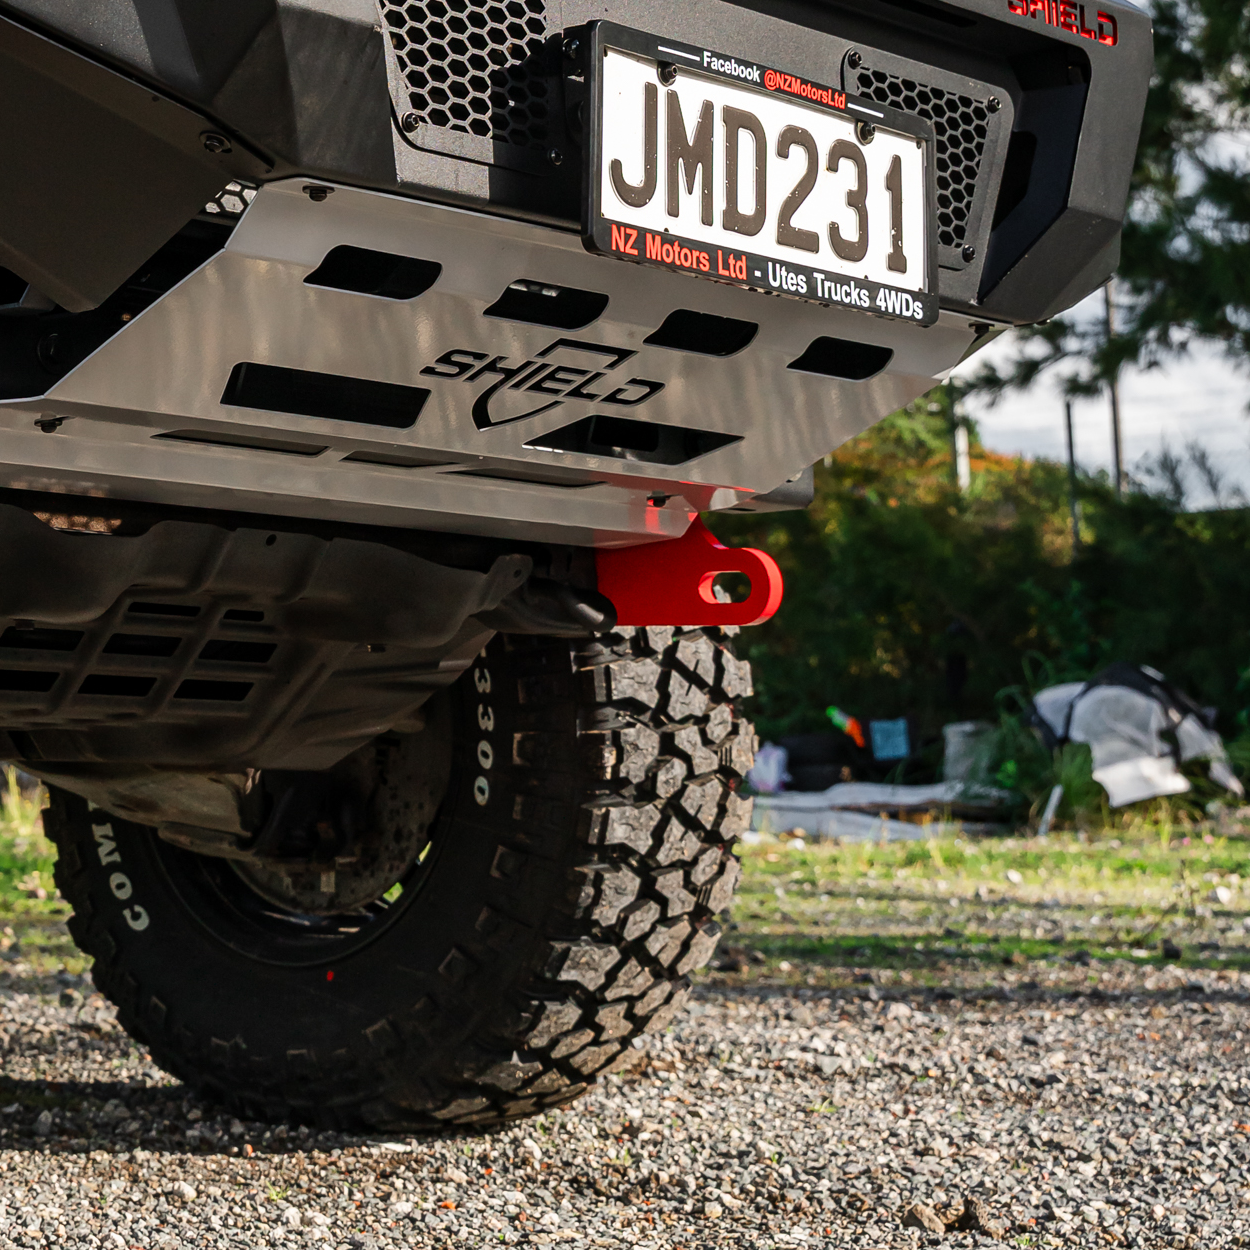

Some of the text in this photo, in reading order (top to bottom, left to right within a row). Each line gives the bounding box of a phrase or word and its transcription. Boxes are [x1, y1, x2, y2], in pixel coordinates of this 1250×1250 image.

[703, 51, 846, 109] Facebook @NZMotorsLtd
[609, 81, 907, 274] JMD231
[611, 223, 638, 256] NZ
[645, 232, 710, 272] Motors
[717, 249, 747, 280] Ltd
[768, 261, 807, 294] Utes
[813, 271, 870, 308] Trucks
[875, 287, 924, 320] 4WDs
[419, 348, 666, 407] SHIELD
[473, 646, 495, 807] 3300
[87, 798, 151, 932] COM
